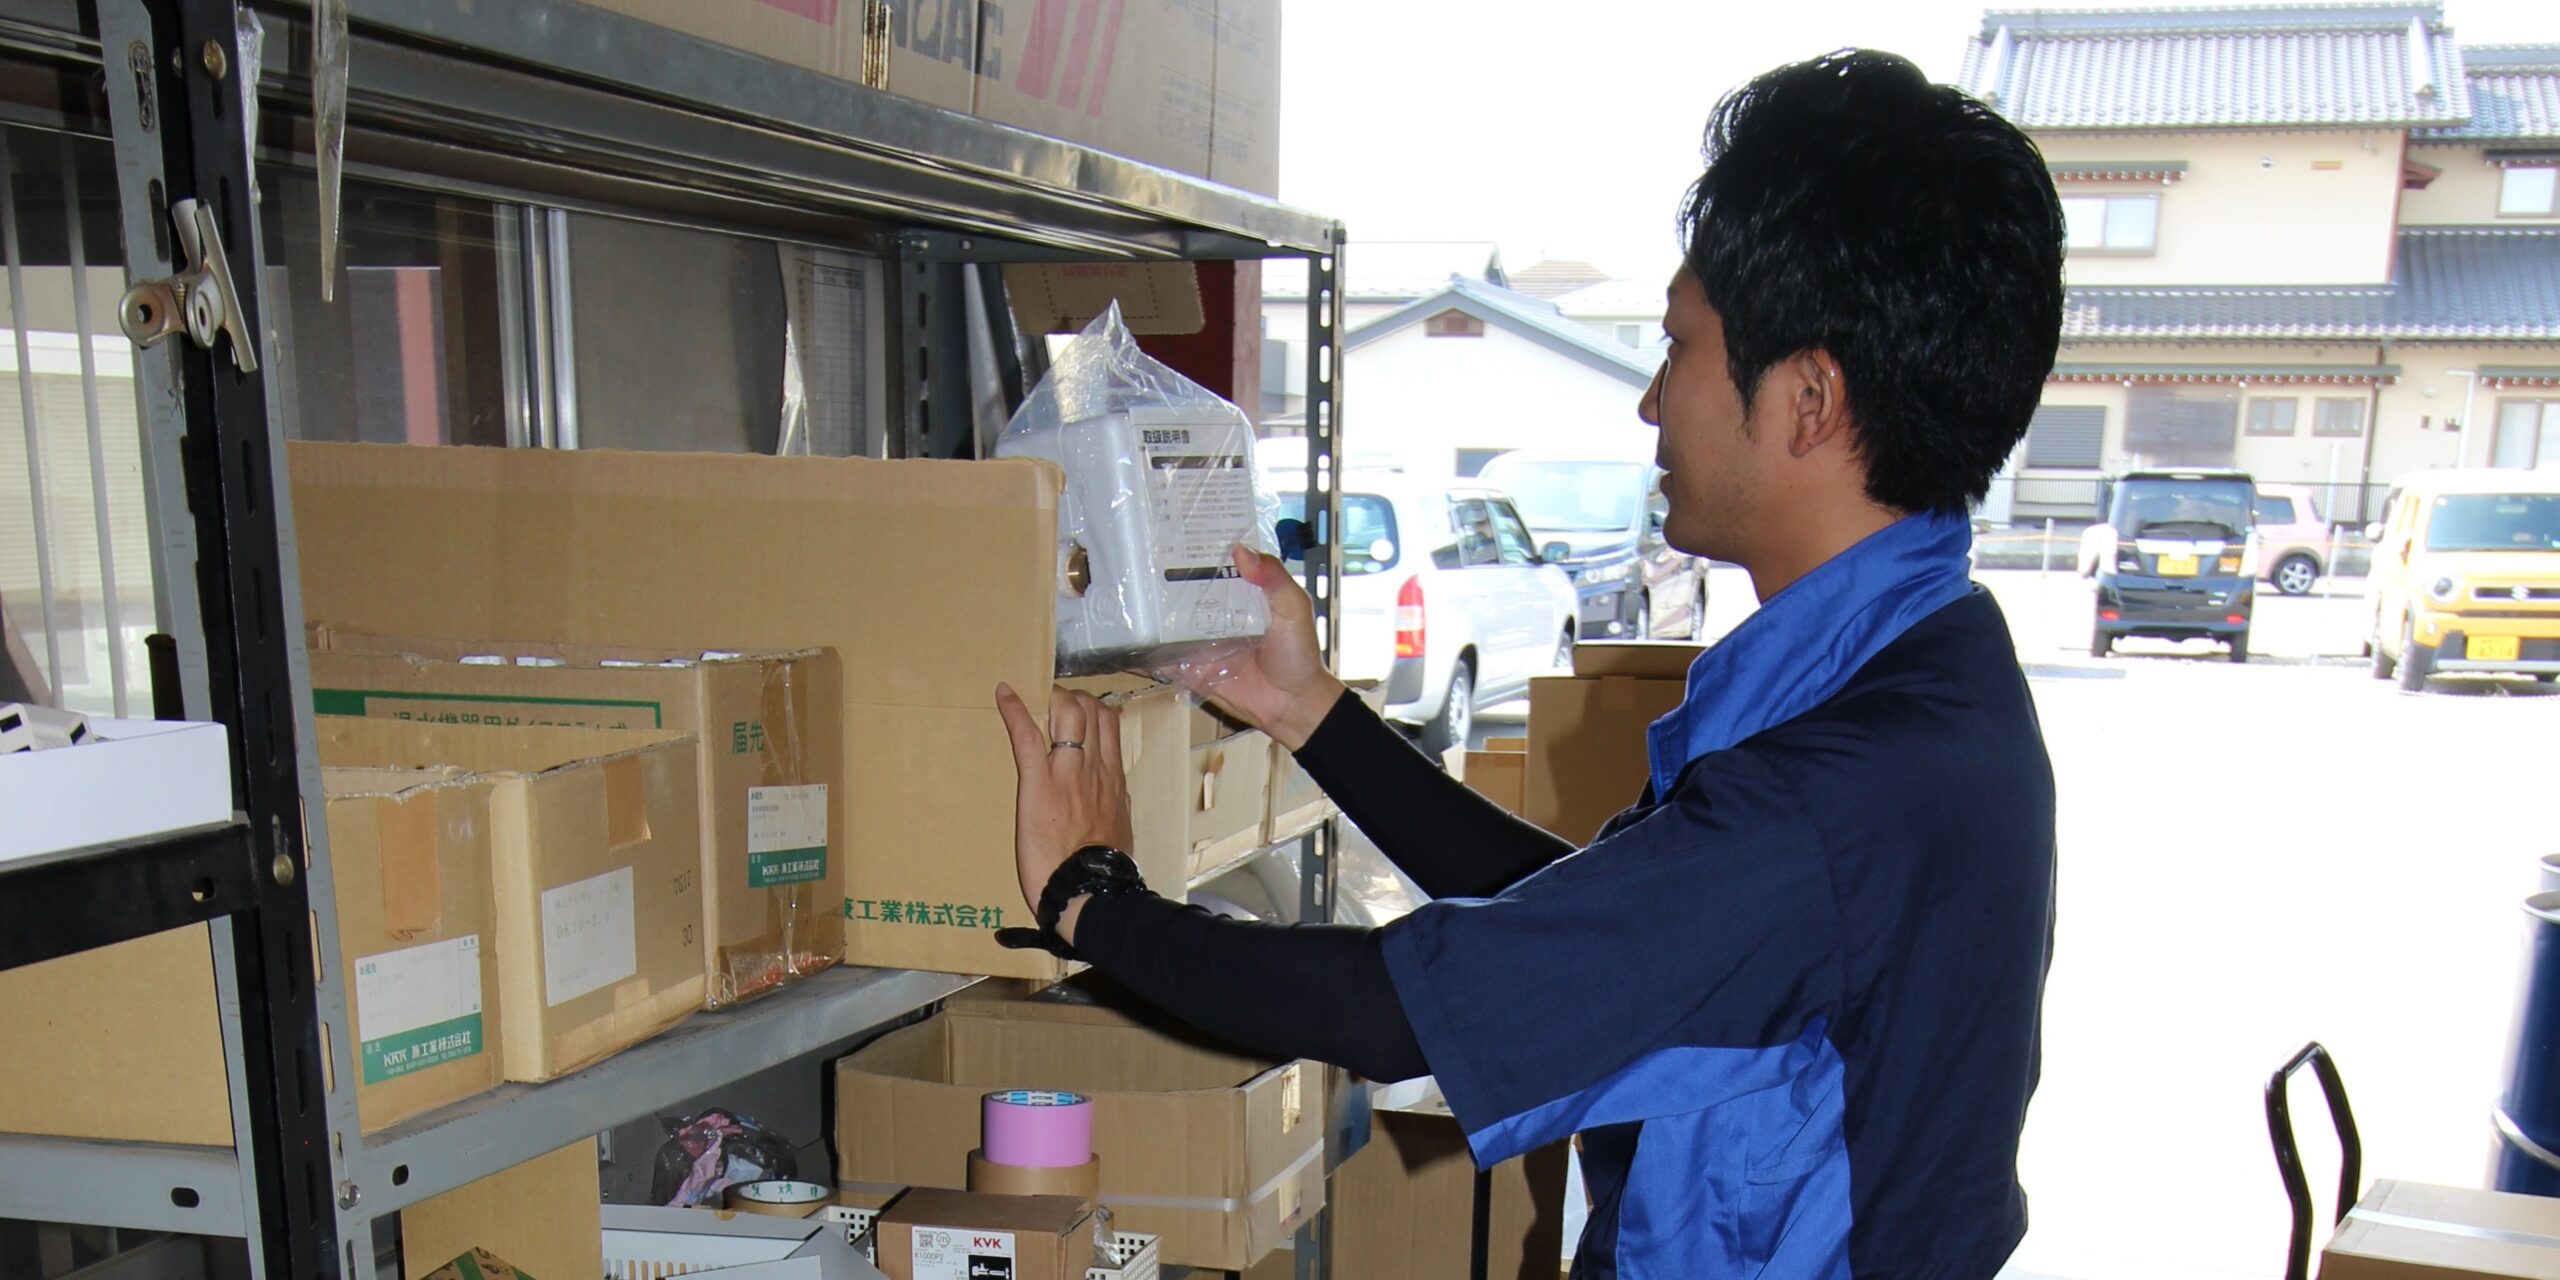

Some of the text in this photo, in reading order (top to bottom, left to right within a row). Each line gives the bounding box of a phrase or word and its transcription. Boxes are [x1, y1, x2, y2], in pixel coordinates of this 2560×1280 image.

[1142, 430, 1190, 444] 取扱説明書
[731, 720, 765, 754] 届先
[973, 1236, 1002, 1249] KVK
